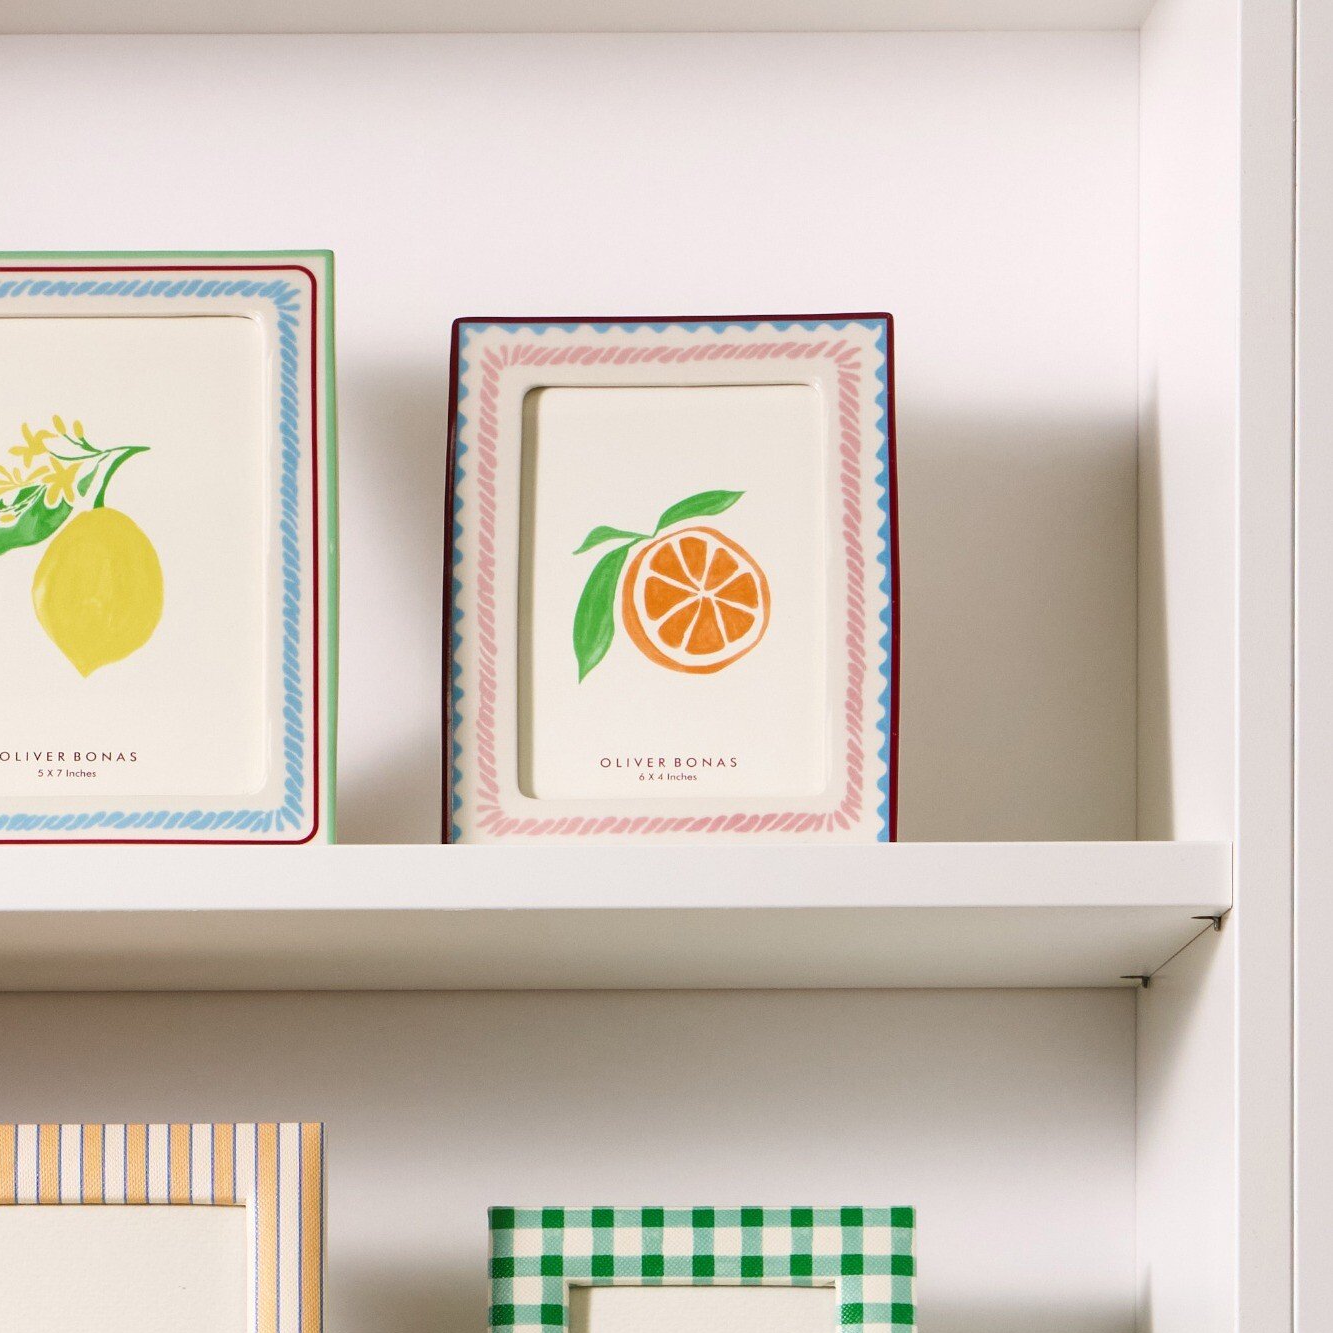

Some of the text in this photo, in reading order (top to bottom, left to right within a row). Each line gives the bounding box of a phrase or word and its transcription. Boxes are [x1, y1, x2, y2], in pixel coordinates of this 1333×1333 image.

[0, 751, 137, 762] OLIVER BONAS
[600, 757, 738, 768] OLIVER BONAS
[66, 769, 97, 778] Inches
[667, 773, 698, 781] Inches
